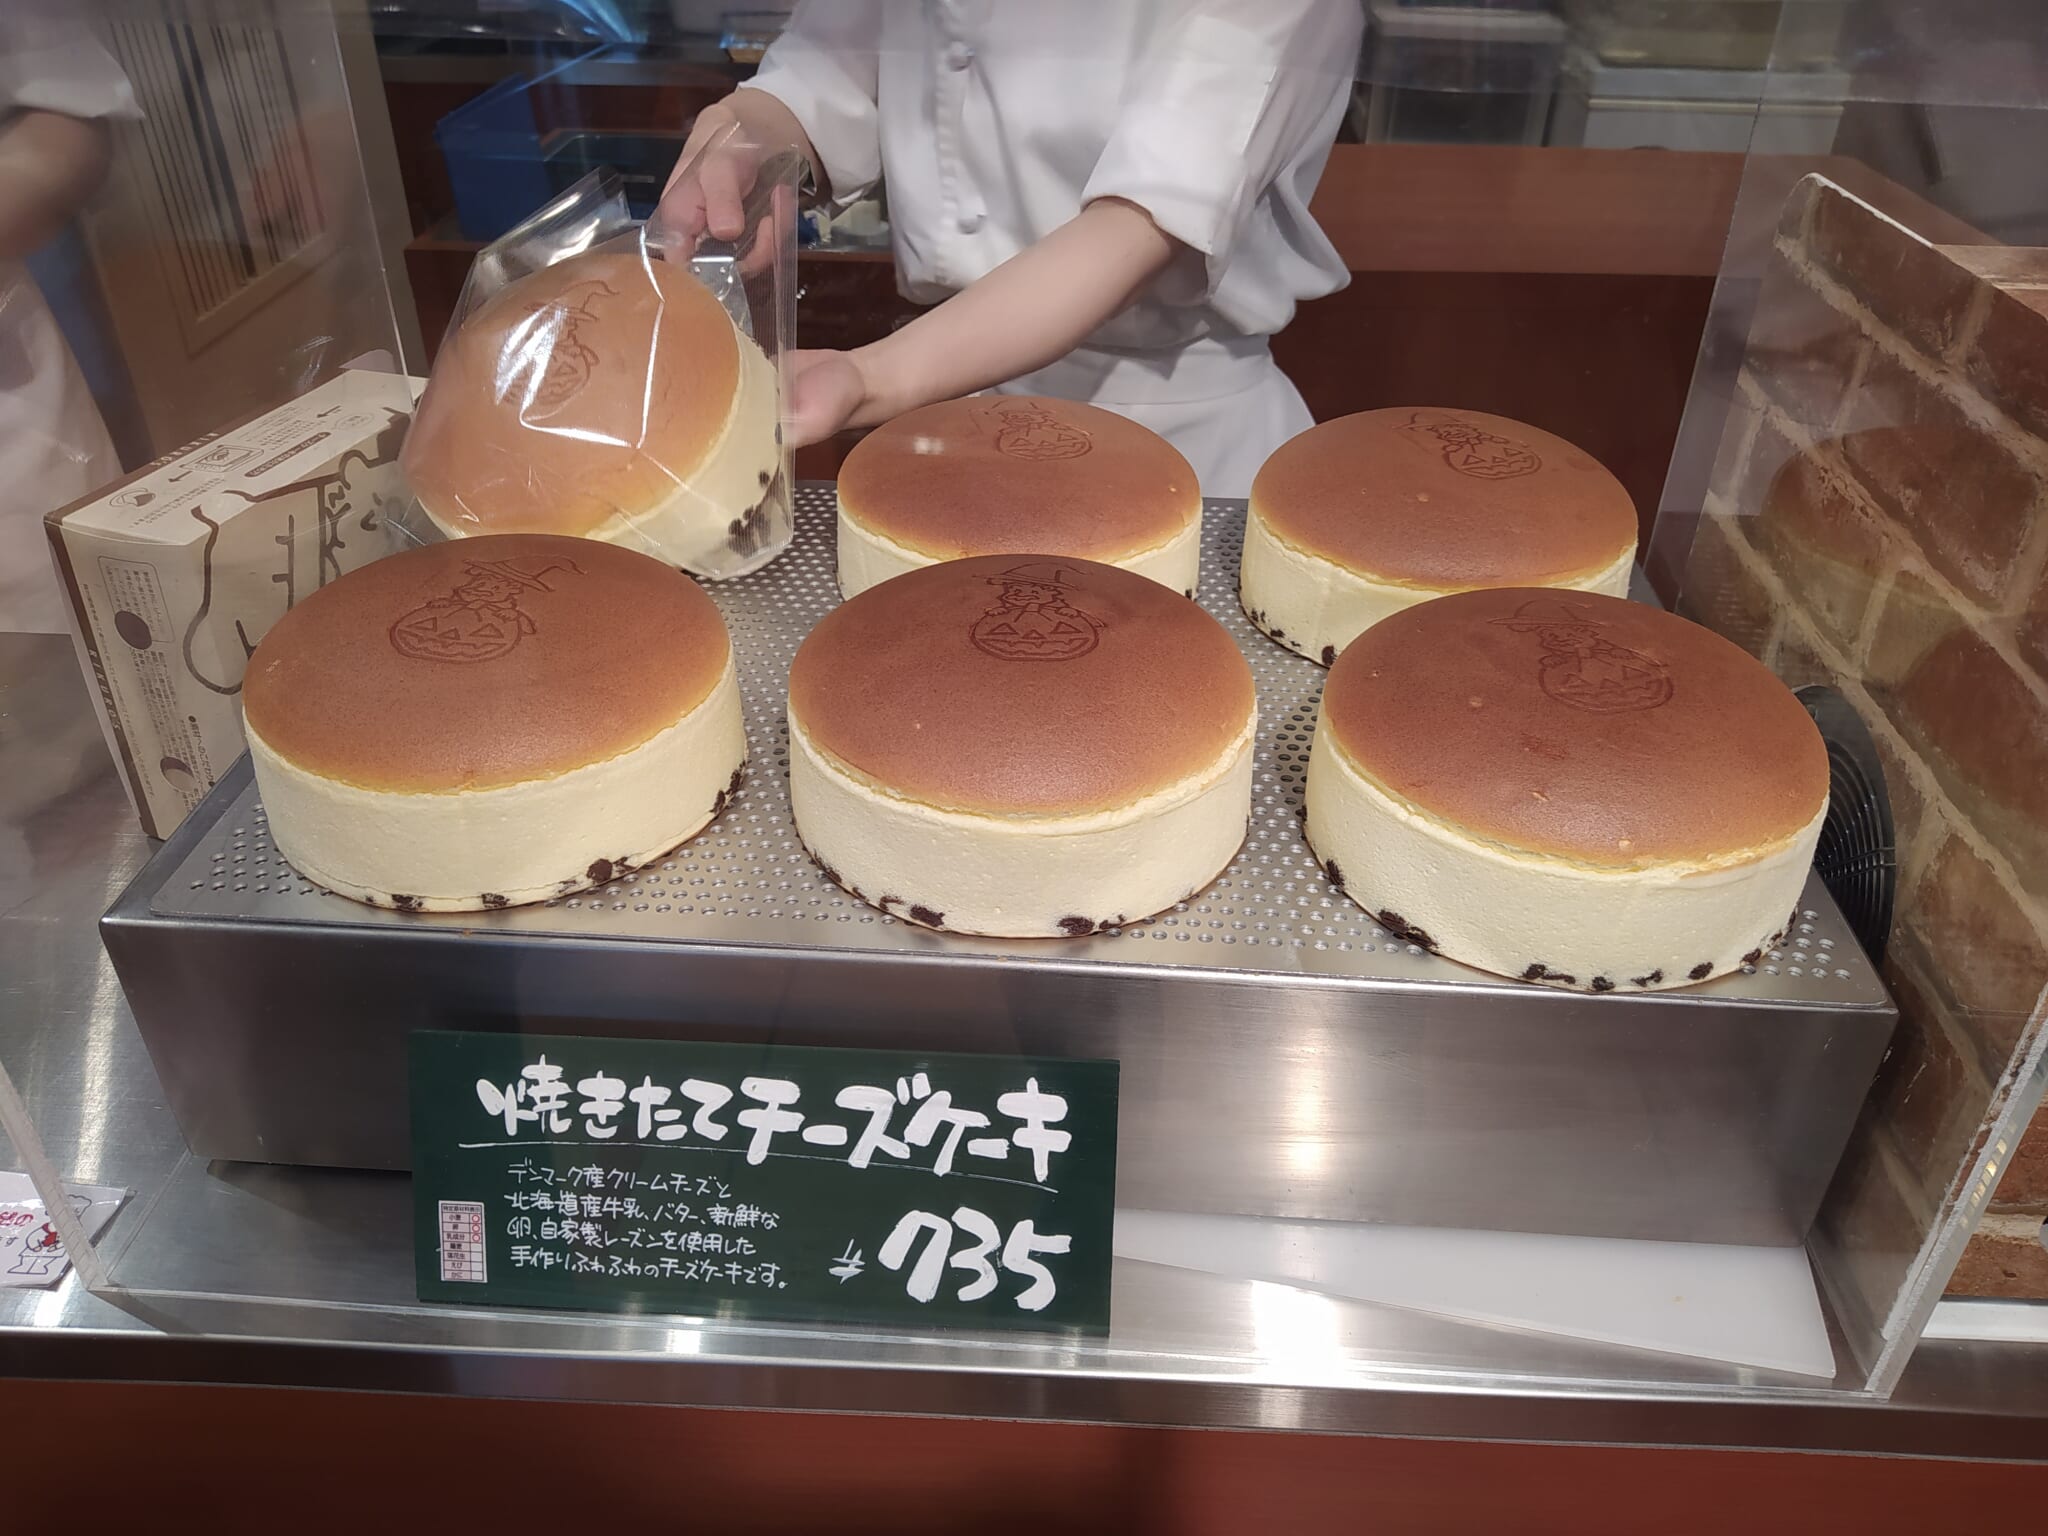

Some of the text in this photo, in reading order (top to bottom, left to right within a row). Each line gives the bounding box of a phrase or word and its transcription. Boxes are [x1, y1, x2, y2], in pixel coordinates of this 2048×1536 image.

[476, 1054, 1072, 1182] 焼きたてチーズケーキ
[507, 1157, 732, 1198] デンマーク産クリームチーズと
[506, 1216, 757, 1255] 卵、自家製レーズンを使用した
[510, 1245, 788, 1288] 手作りふわふわのチーズケーキです。
